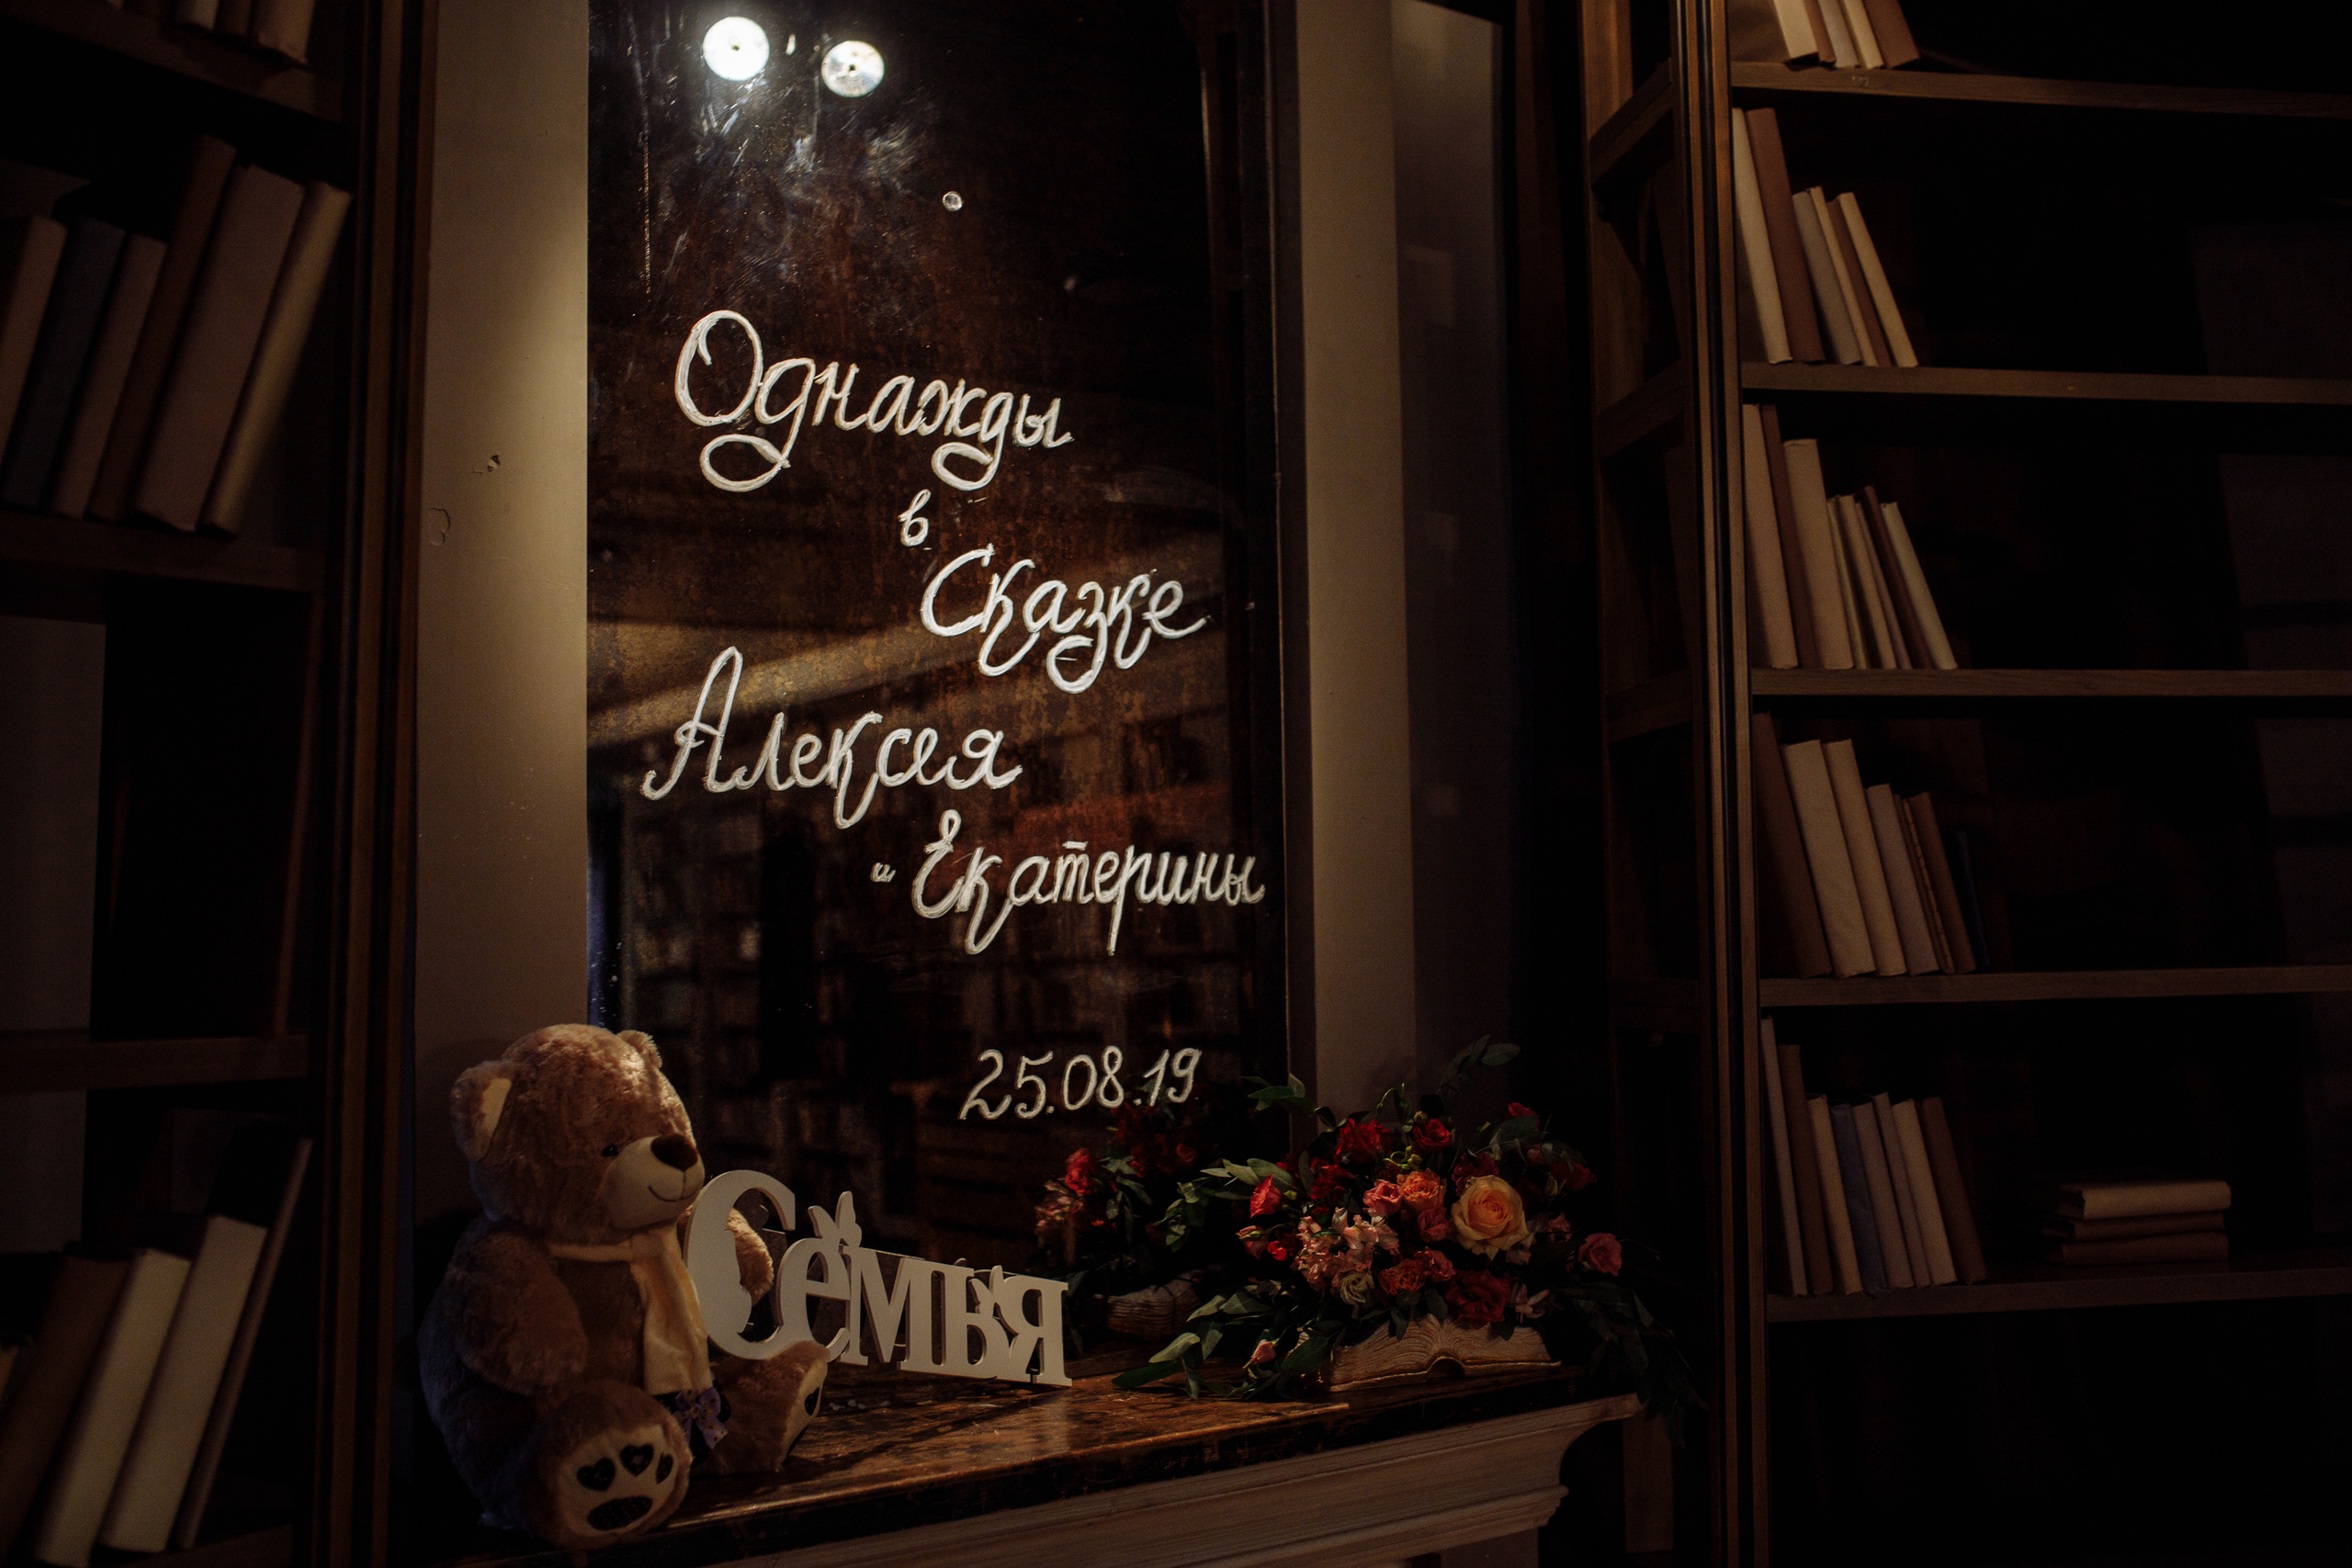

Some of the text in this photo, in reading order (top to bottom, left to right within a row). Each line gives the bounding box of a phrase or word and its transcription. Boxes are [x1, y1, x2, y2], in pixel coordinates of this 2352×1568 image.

[675, 310, 1073, 491] Однажды
[899, 489, 931, 547] в
[922, 543, 1211, 694] Сказке
[642, 646, 1023, 829] Алексея
[912, 809, 1265, 955] Екатерины
[957, 1045, 1201, 1120] 25.08.19
